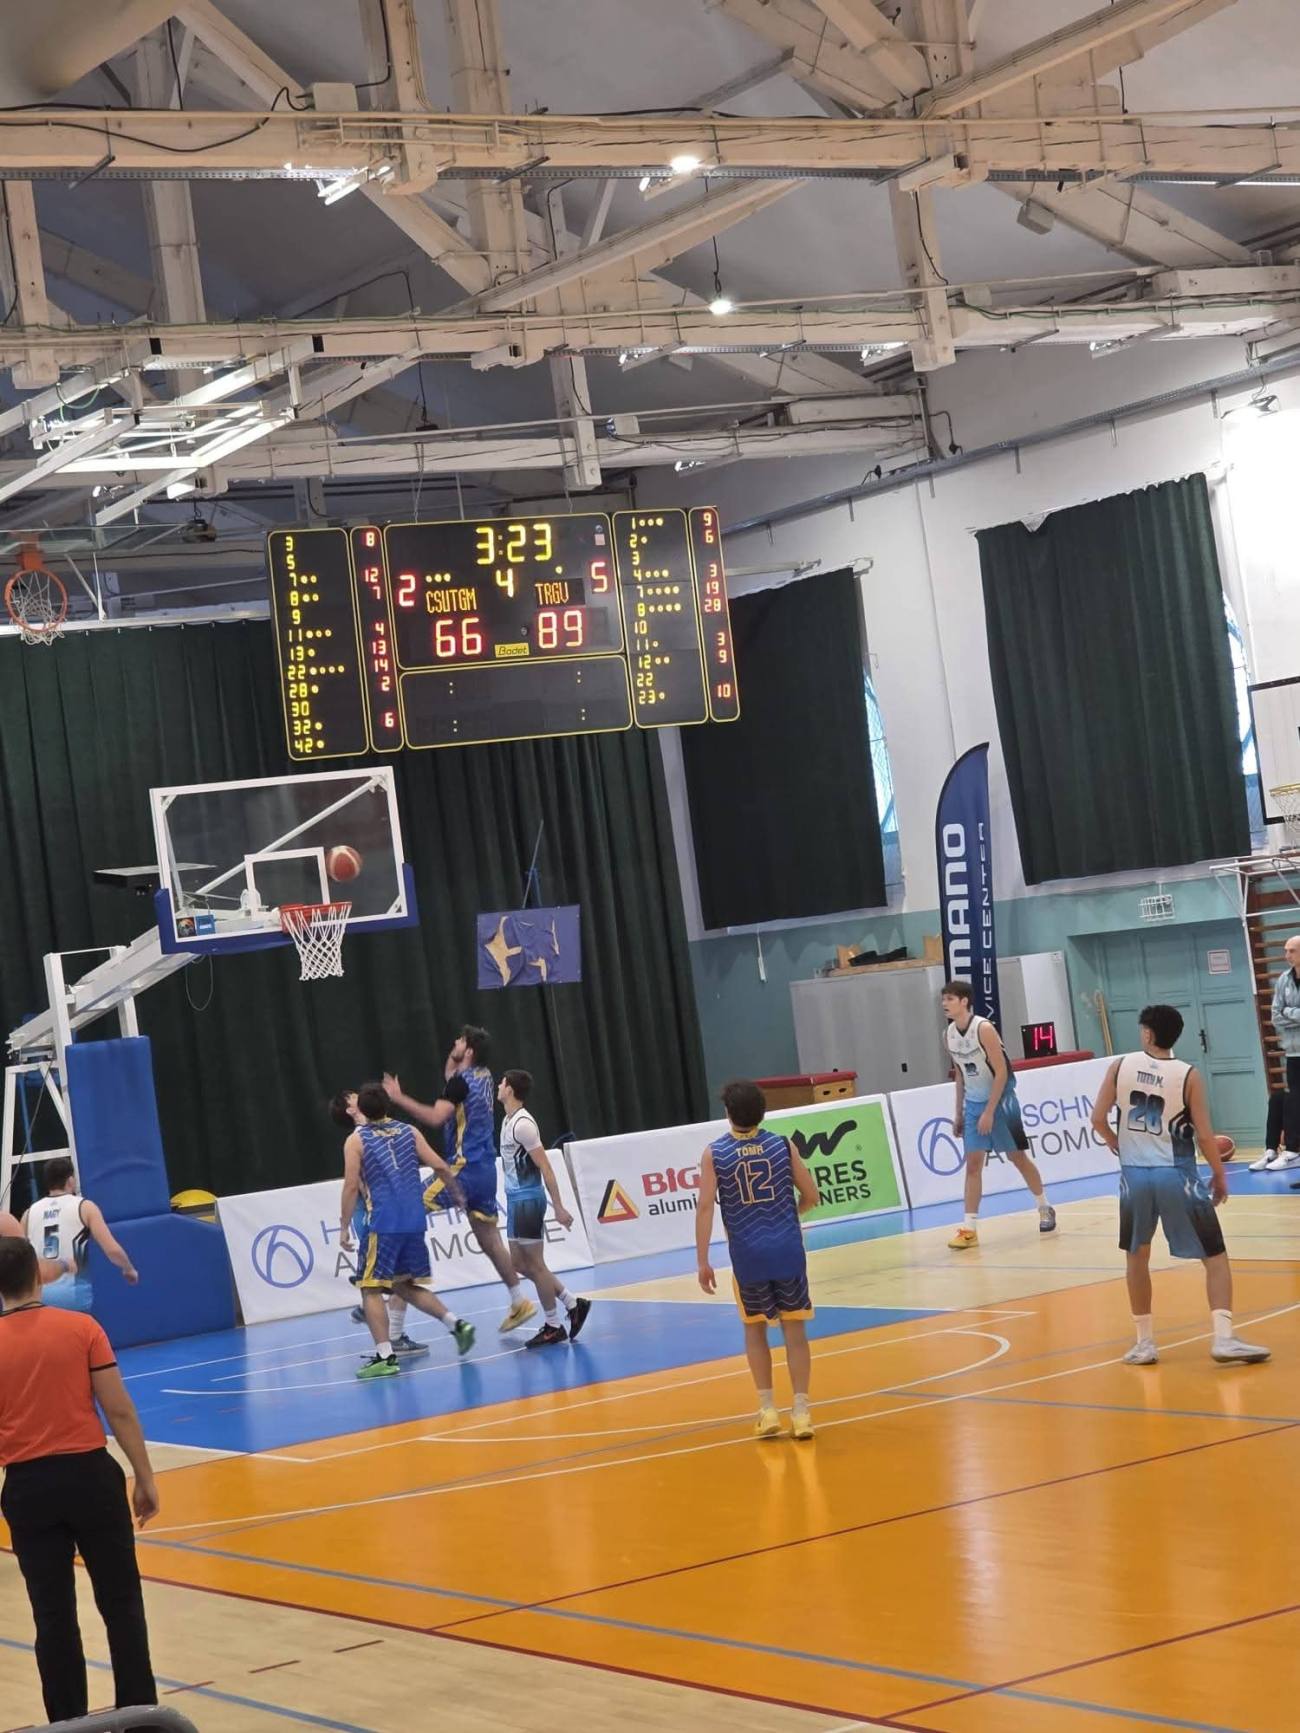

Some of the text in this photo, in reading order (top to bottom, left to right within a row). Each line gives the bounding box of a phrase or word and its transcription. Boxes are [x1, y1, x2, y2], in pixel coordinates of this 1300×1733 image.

[631, 518, 636, 530] 1
[703, 512, 712, 526] 9
[285, 536, 293, 552] 3
[365, 532, 375, 546] 8
[630, 534, 637, 548] 2
[705, 530, 713, 544] 6
[476, 524, 552, 565] 3:23
[287, 554, 295, 570] 5
[632, 552, 640, 565] 3
[365, 569, 378, 583] 12
[591, 562, 608, 593] 5
[634, 569, 641, 581] 4
[710, 564, 718, 577] 3
[290, 573, 297, 587] 7
[496, 568, 514, 597] 4
[373, 587, 381, 600] 7
[399, 574, 415, 606] 2
[637, 586, 643, 598] 7
[706, 581, 719, 594] 19
[290, 591, 299, 606] 8
[704, 598, 721, 612] 28
[292, 610, 301, 624] 9
[637, 603, 646, 617] 8
[375, 623, 384, 635] 4
[538, 610, 583, 649] 89
[634, 620, 647, 635] 10
[288, 629, 303, 642] 11
[435, 617, 482, 657] 66
[717, 633, 725, 646] 3
[373, 640, 387, 654] 13
[637, 639, 648, 651] 11
[290, 647, 304, 661] 13
[719, 650, 727, 663] 9
[374, 659, 388, 672] 14
[638, 655, 651, 669] 12
[288, 666, 306, 680] 22
[637, 673, 653, 686] 22
[289, 684, 307, 698] 28
[382, 677, 390, 691] 2
[717, 684, 730, 697] 10
[639, 690, 656, 704] 23
[291, 702, 310, 717] 30
[385, 713, 394, 727] 6
[293, 720, 312, 735] 32
[294, 738, 312, 753] 42
[943, 823, 973, 981] MANO
[982, 957, 998, 1020] VICE
[1034, 1025, 1054, 1051] 14
[808, 1160, 868, 1188] RES
[735, 1159, 775, 1204] 12
[818, 1183, 872, 1206] NERS
[43, 1224, 59, 1259] 5
